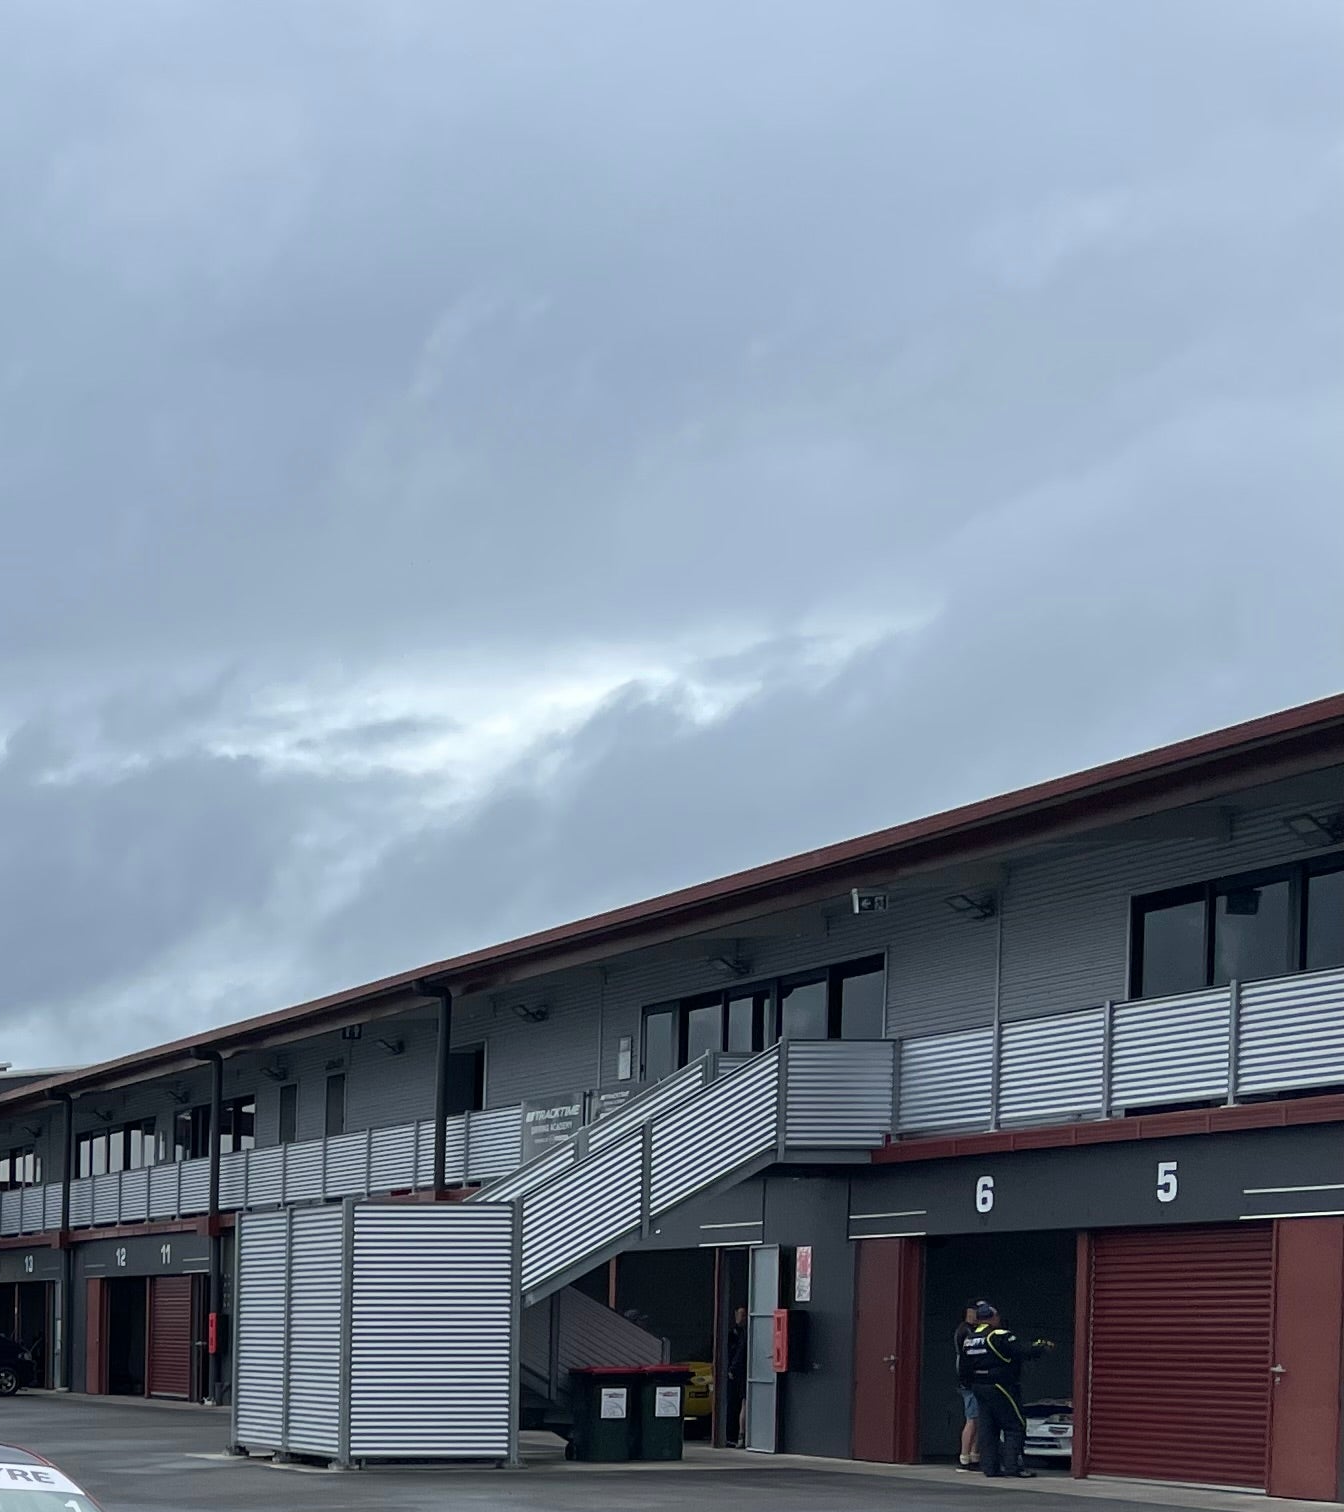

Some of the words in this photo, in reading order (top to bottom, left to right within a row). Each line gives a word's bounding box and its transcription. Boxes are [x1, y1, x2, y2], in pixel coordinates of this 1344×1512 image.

[975, 1175, 994, 1213] 6
[1157, 1161, 1178, 1202] 5
[116, 1248, 127, 1266] 12
[161, 1244, 171, 1264] 11
